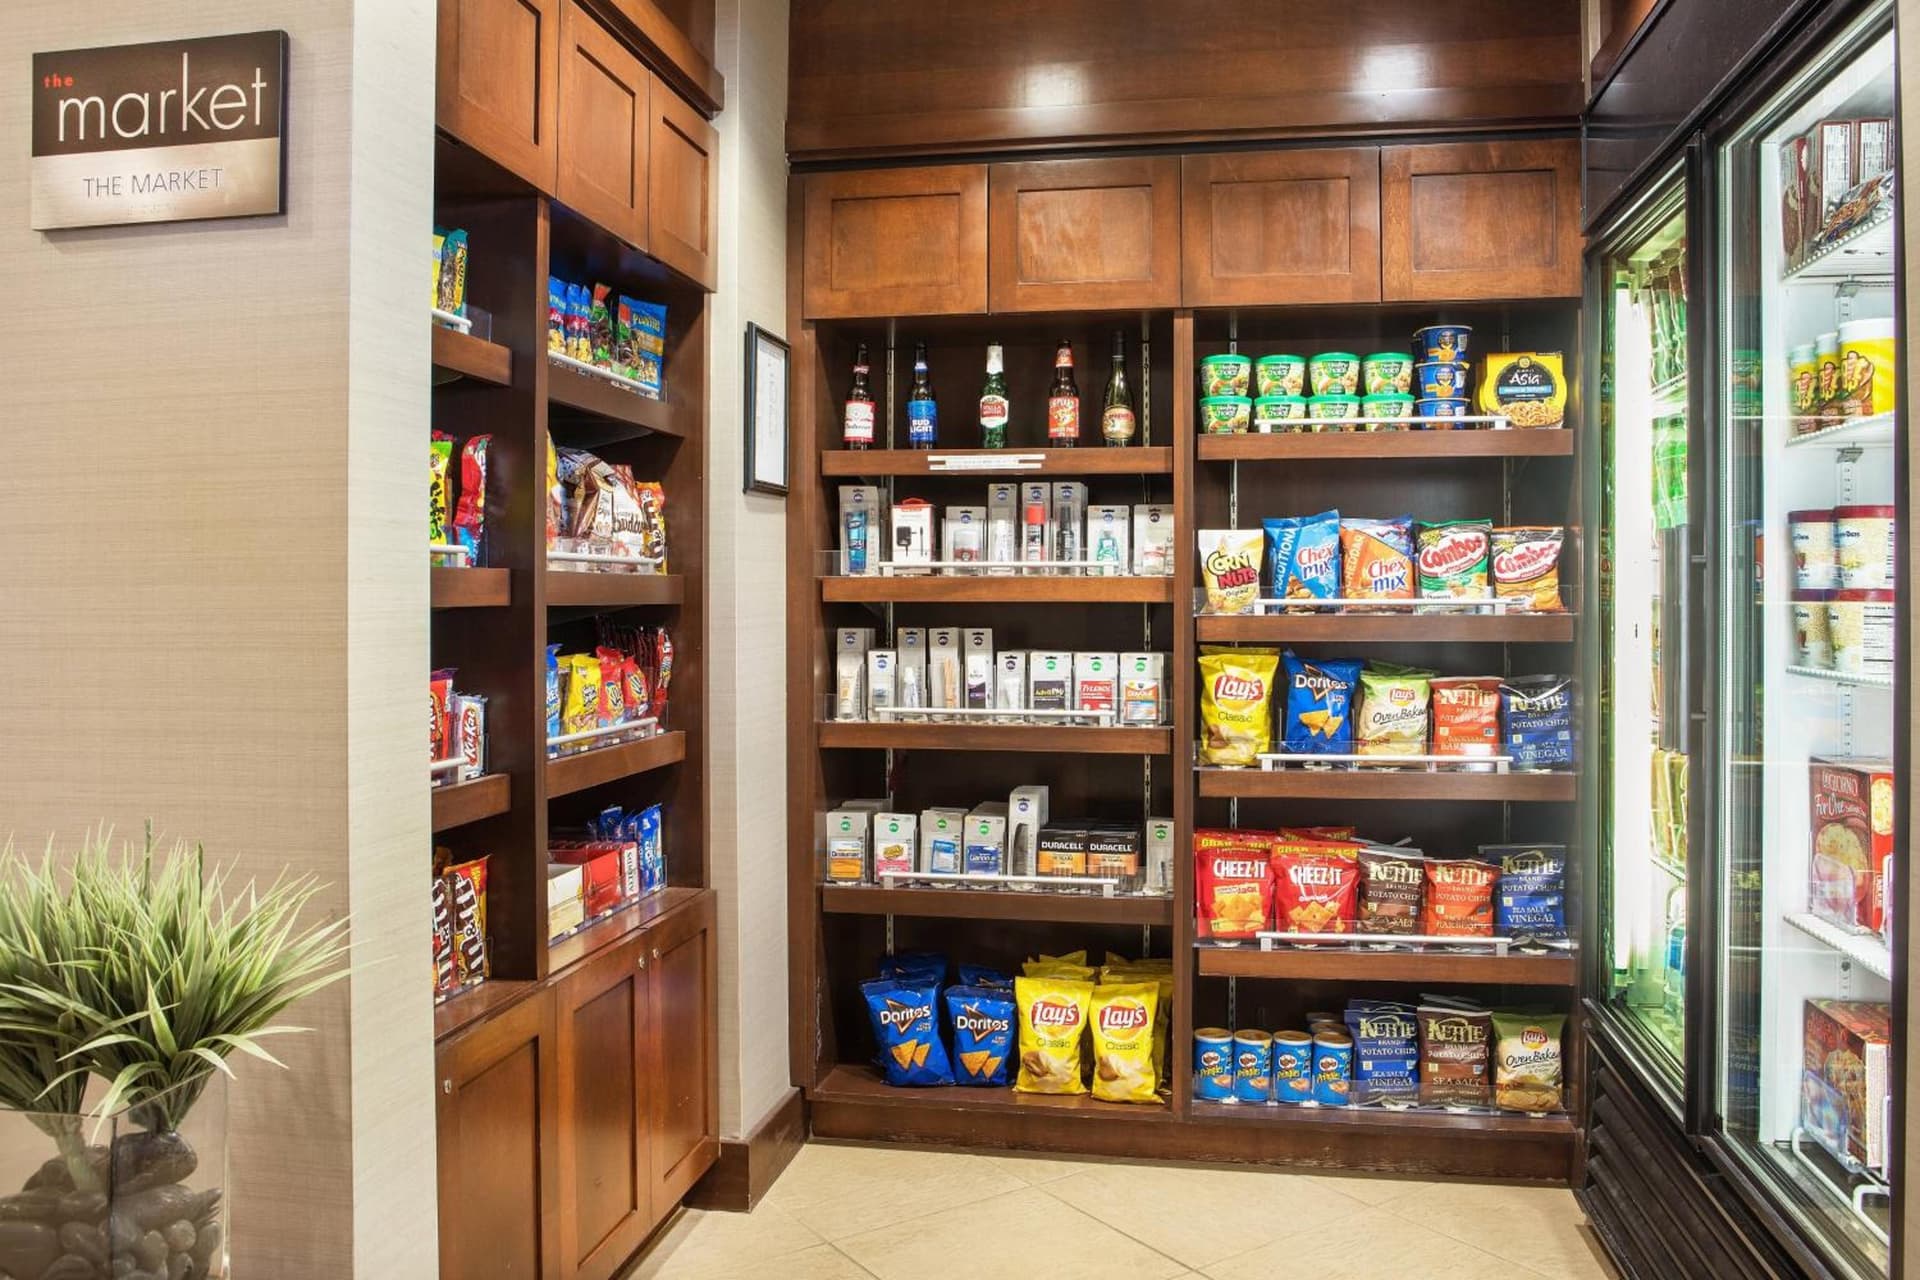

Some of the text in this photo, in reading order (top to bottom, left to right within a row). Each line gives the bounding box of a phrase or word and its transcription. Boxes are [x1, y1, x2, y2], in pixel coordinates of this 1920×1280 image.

[43, 73, 74, 88] the
[58, 52, 267, 142] market
[83, 168, 223, 198] THE MARKET
[1509, 372, 1541, 385] Asia
[1207, 551, 1250, 576] CORN
[1297, 544, 1335, 566] Chex
[1368, 557, 1406, 578] Chex
[1217, 567, 1258, 589] NUTS
[1295, 674, 1347, 690] Doritos
[1518, 749, 1568, 760] VINEGAR
[1041, 841, 1082, 849] DURACELL
[1090, 843, 1132, 852] DURACELL
[880, 1005, 931, 1024] Doritos
[1034, 1000, 1077, 1025] Lay's
[1103, 1004, 1145, 1029] Lay's
[957, 1015, 1009, 1031] Doritos
[1361, 1048, 1393, 1056] POTATO
